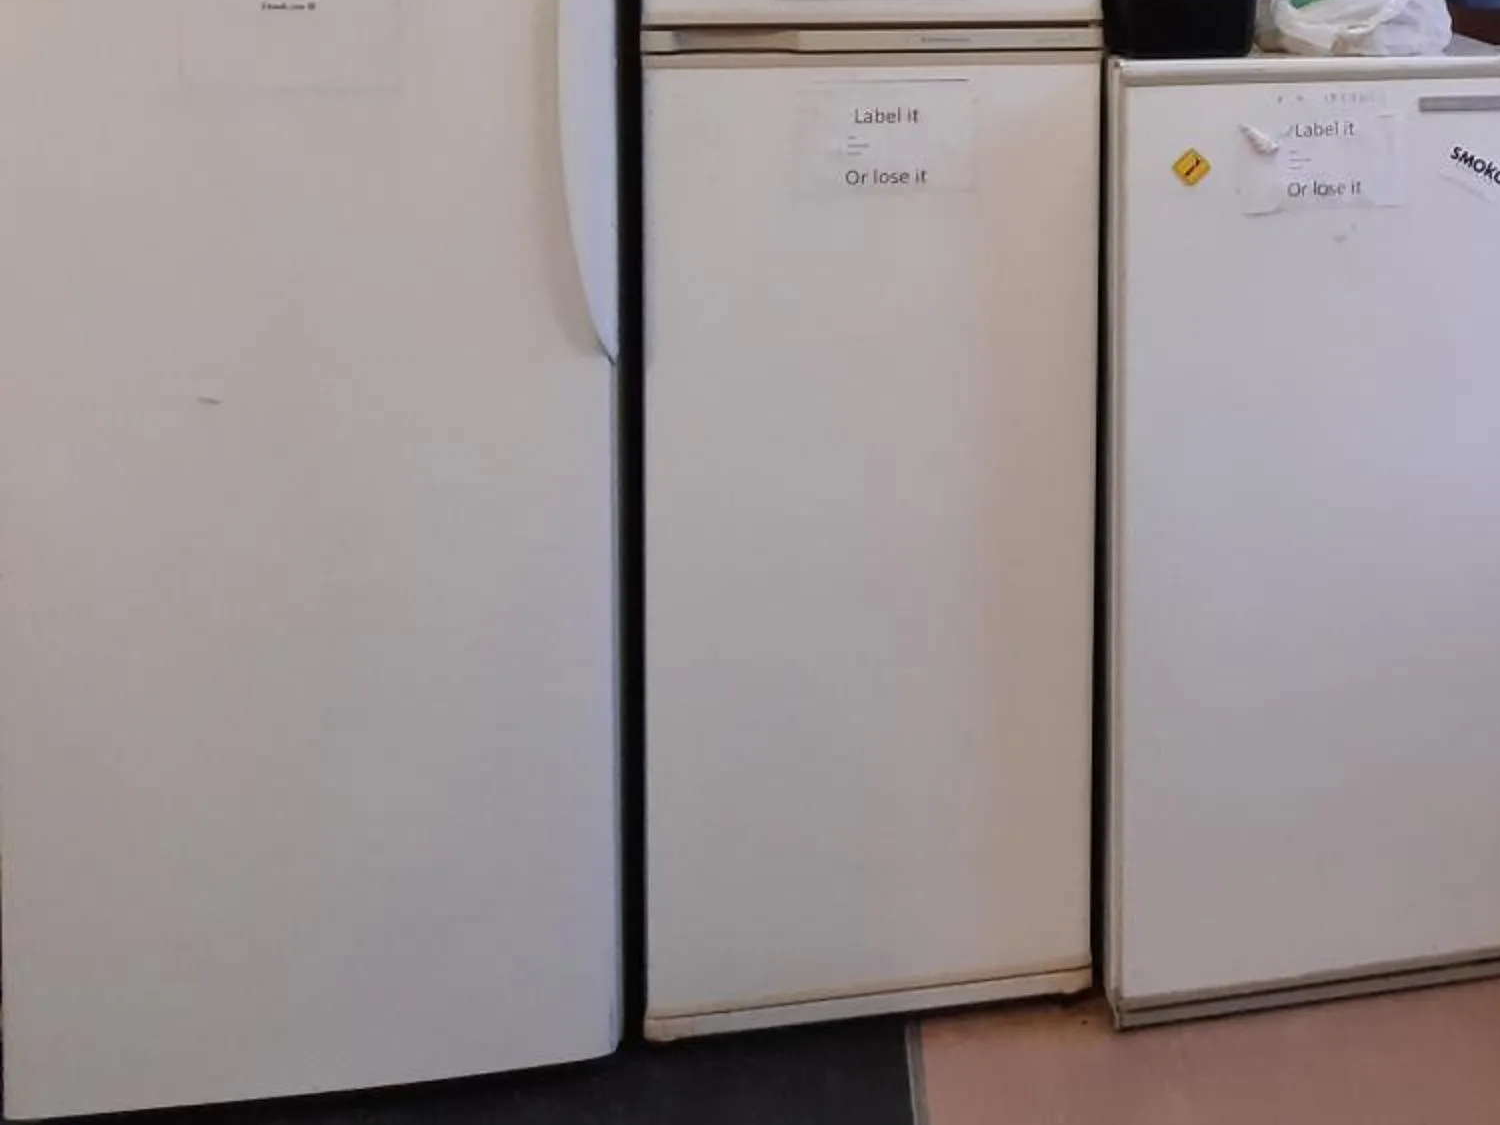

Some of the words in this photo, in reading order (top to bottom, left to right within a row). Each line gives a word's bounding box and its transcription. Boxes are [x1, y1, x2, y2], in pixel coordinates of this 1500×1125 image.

[854, 107, 901, 123] Label
[908, 108, 918, 123] it
[1295, 122, 1339, 137] Label
[1343, 122, 1355, 136] it
[845, 170, 868, 185] Or
[873, 169, 910, 184] lose
[915, 169, 927, 184] it
[1287, 182, 1308, 197] Or
[1313, 180, 1346, 196] lose
[1351, 181, 1362, 195] it
